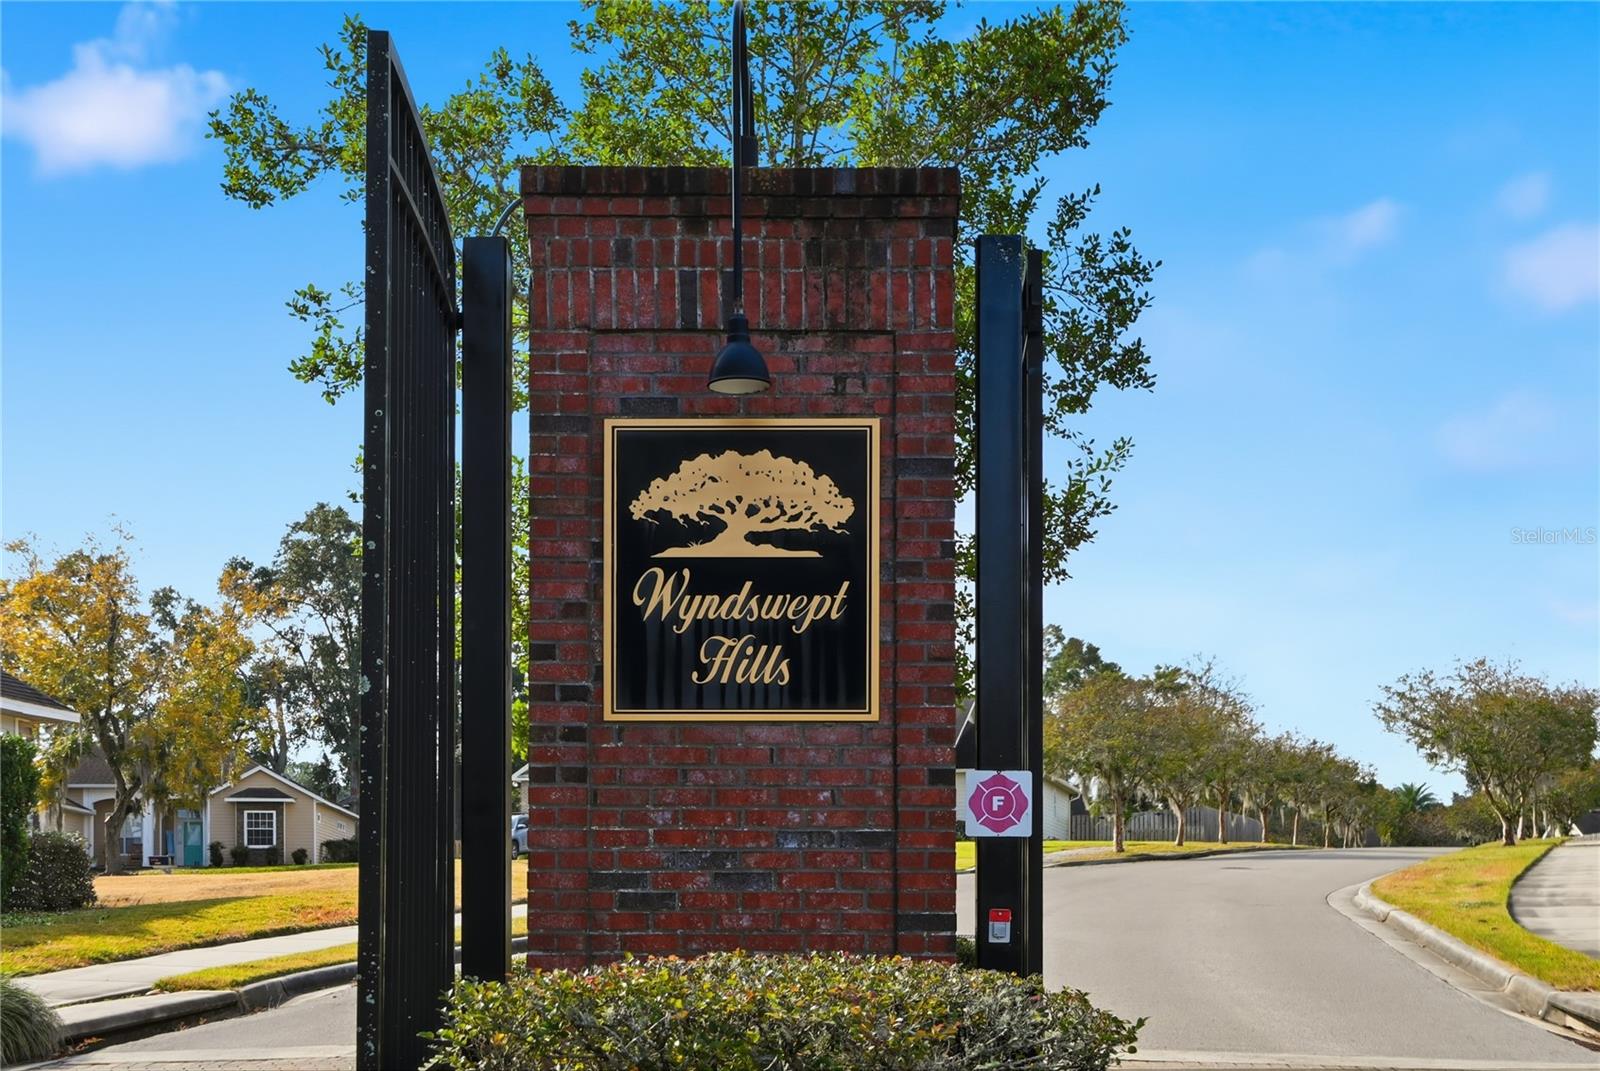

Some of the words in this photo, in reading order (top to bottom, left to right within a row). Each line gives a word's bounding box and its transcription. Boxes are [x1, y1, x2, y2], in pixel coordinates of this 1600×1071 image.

[632, 566, 850, 634] Wyndswept
[691, 634, 790, 686] Hills
[991, 795, 1005, 811] F
